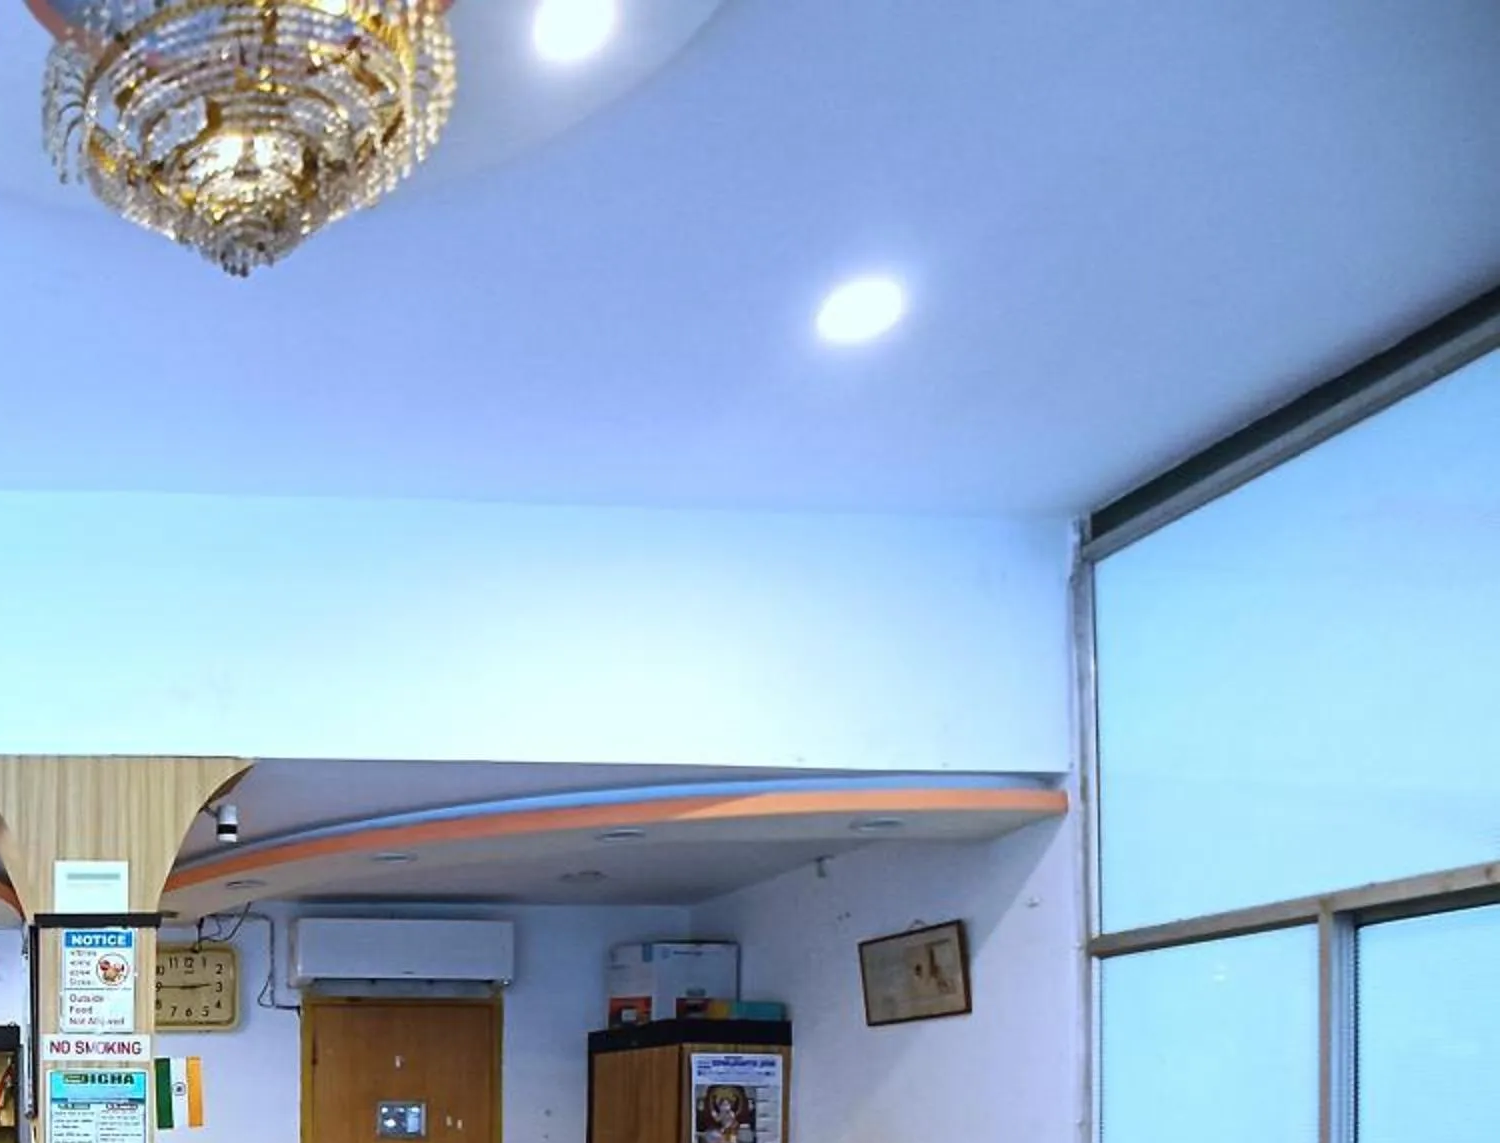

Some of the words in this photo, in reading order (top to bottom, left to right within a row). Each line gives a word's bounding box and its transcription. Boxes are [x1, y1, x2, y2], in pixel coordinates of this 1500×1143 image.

[71, 934, 126, 945] NOTICE
[169, 956, 178, 968] 11
[183, 956, 194, 969] 12
[201, 957, 207, 968] 1
[215, 963, 223, 974] 2
[215, 981, 223, 992] 3
[69, 1005, 93, 1014] Food
[215, 999, 221, 1009] 4
[170, 1006, 178, 1017] 7
[185, 1007, 192, 1017] 6
[201, 1006, 209, 1017] 5
[50, 1041, 70, 1054] NO
[75, 1041, 142, 1054] SMOKING
